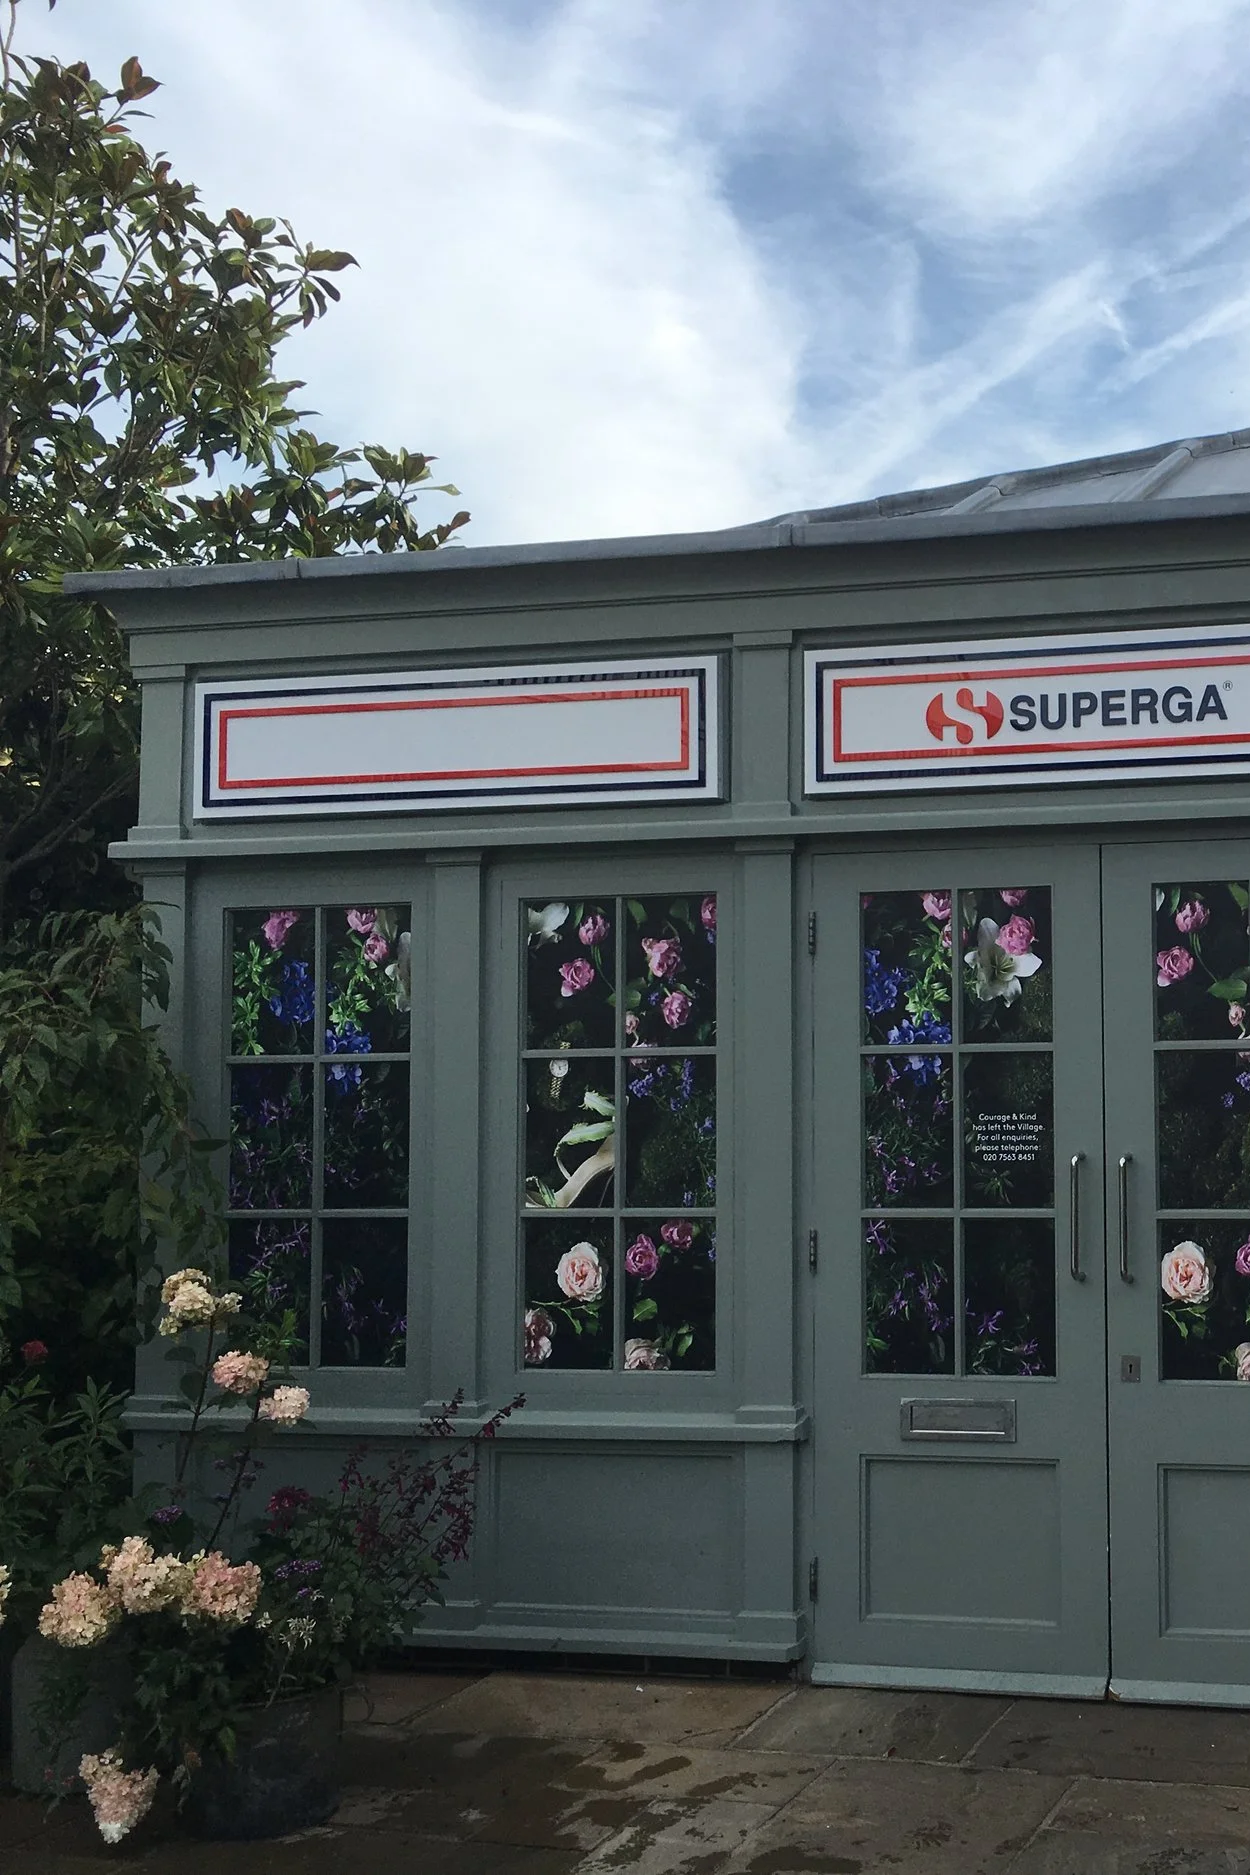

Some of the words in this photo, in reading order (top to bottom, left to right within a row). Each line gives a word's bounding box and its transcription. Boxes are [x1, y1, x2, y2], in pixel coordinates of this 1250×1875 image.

[978, 1113, 1011, 1122] Courage
[972, 1123, 986, 1131] has
[987, 1123, 1001, 1131] left
[1002, 1123, 1016, 1131] the
[1017, 1123, 1045, 1132] Village.
[977, 1133, 989, 1141] For
[990, 1133, 1000, 1141] all
[1001, 1133, 1039, 1142] enquiries,
[974, 1144, 999, 1152] please
[1001, 1144, 1041, 1152] telephone:
[982, 1153, 997, 1161] 020
[998, 1153, 1016, 1161] 7563
[1017, 1153, 1035, 1161] 8451
